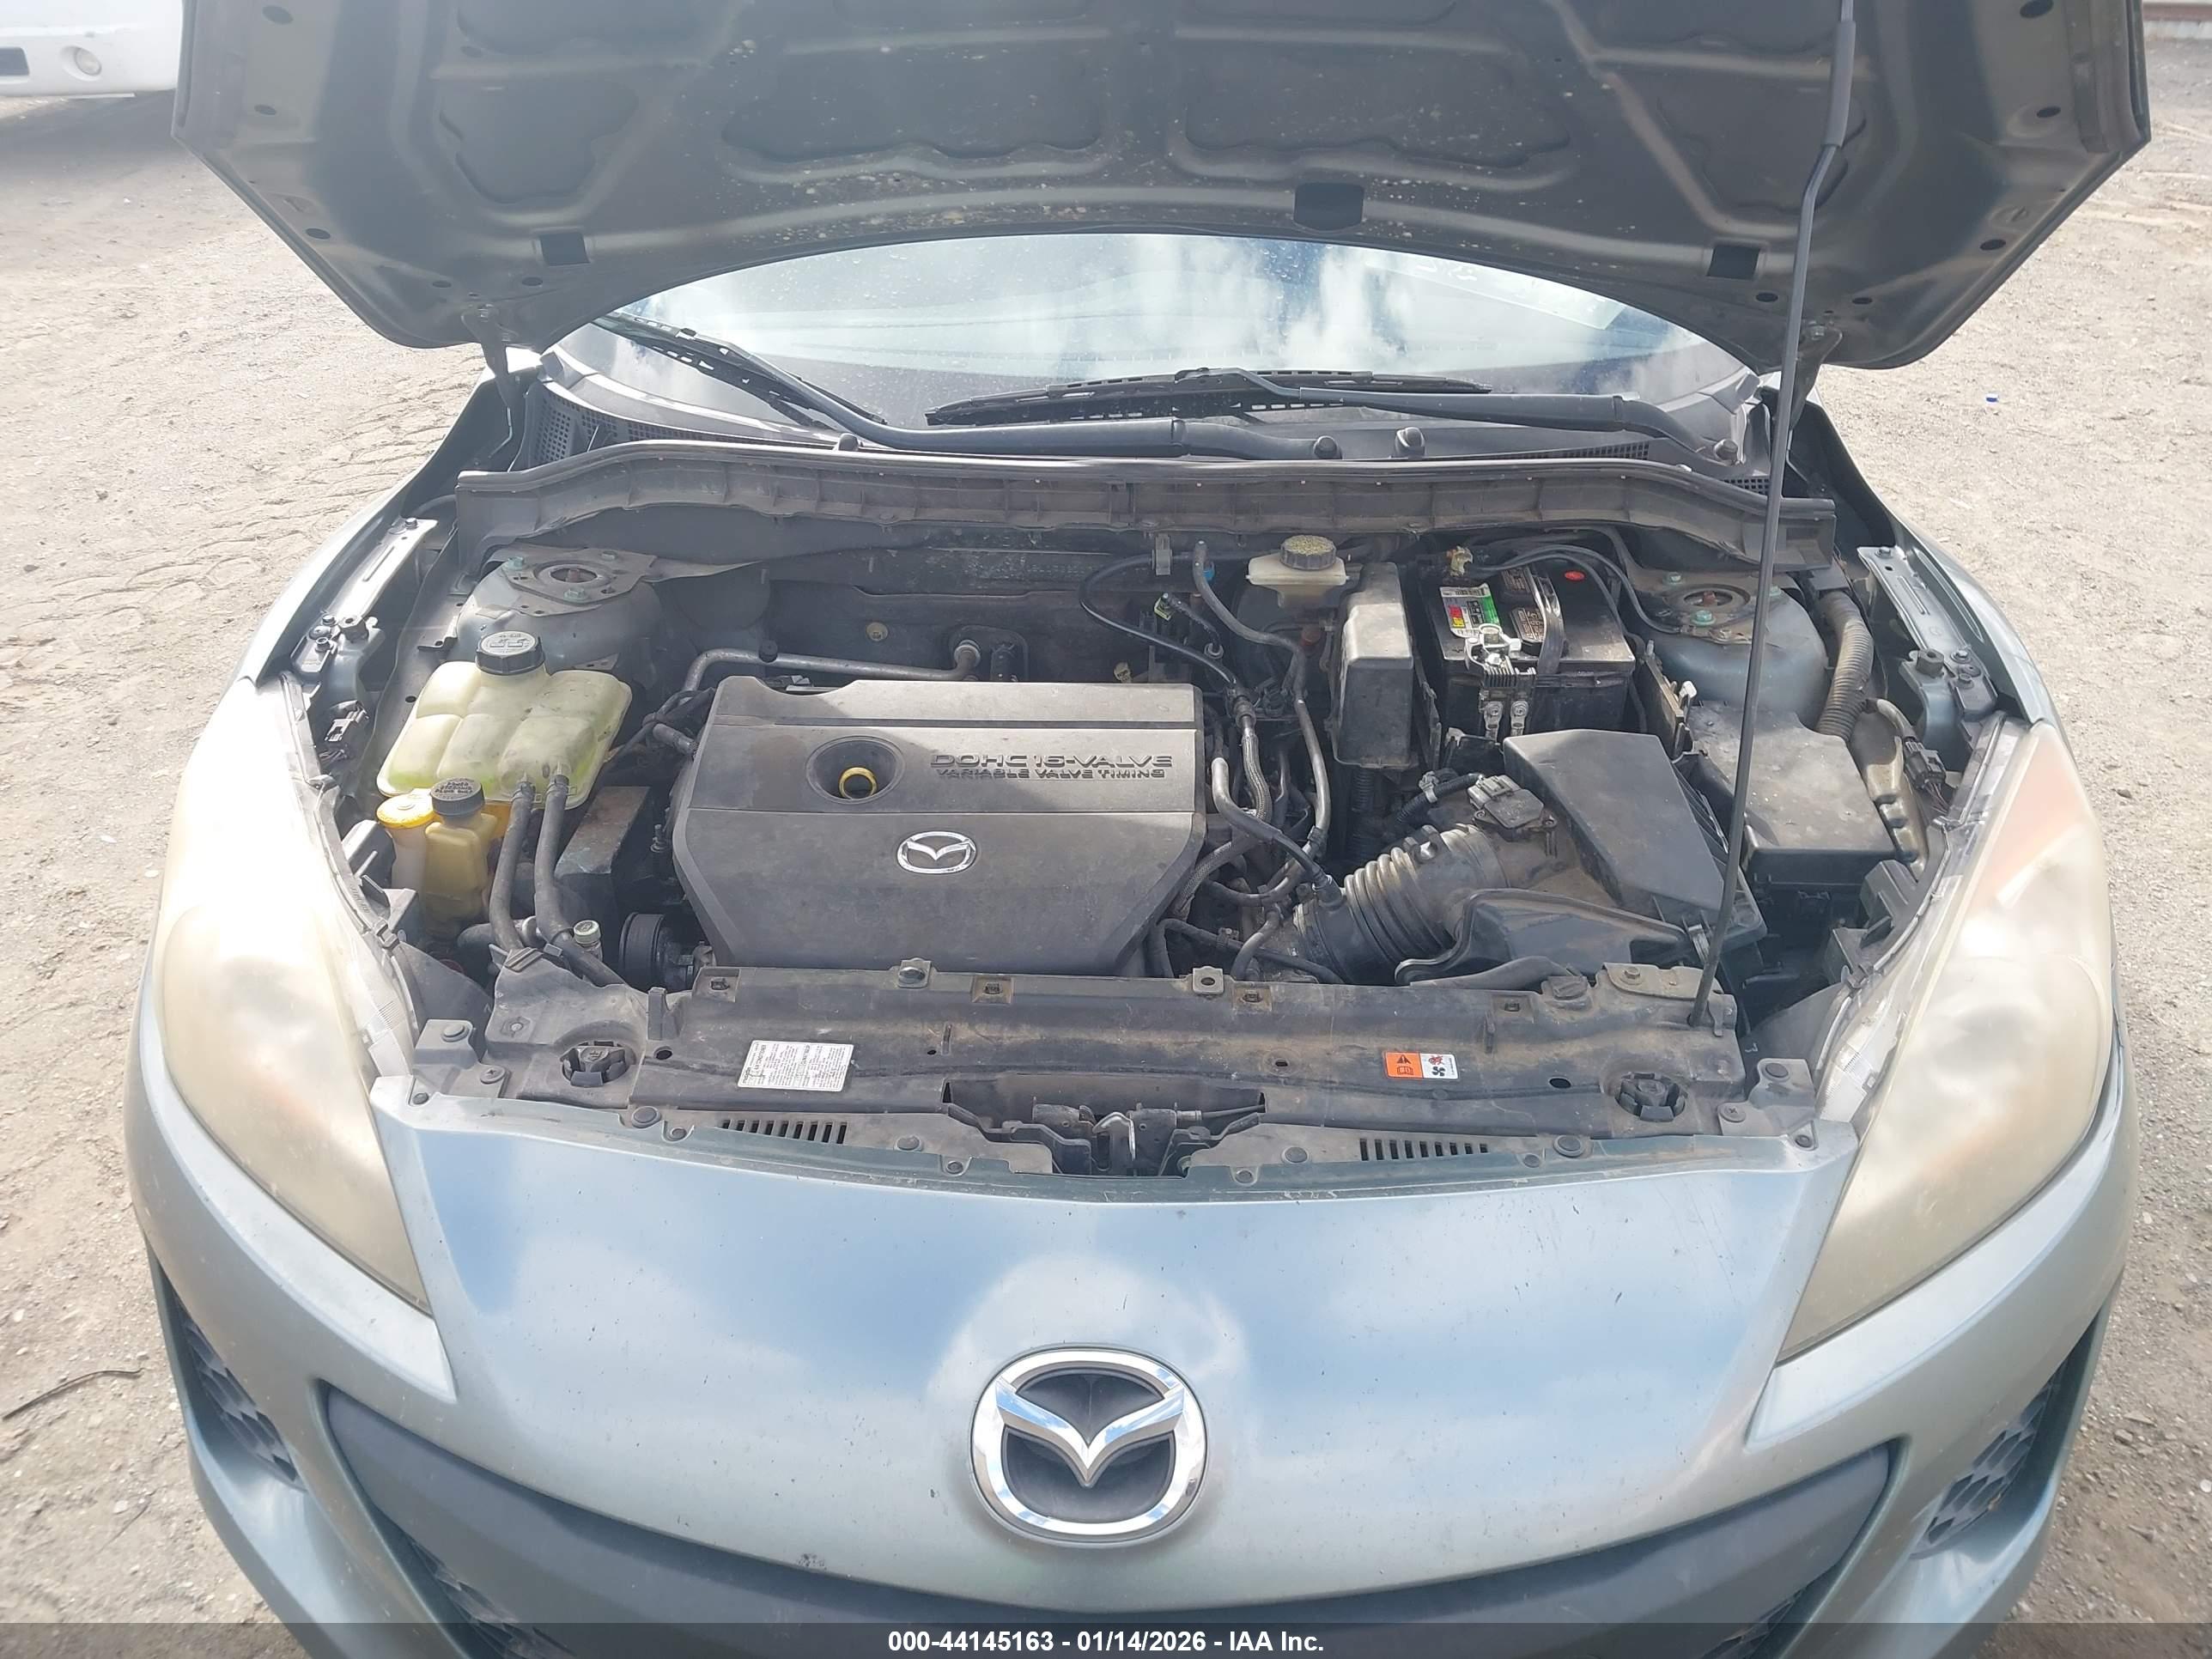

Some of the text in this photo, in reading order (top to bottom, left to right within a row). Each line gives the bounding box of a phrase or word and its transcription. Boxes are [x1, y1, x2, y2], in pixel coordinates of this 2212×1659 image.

[931, 755, 1173, 768] DOHC 16-VALVE
[936, 769, 1165, 779] VARIABLE VALVE TIMING
